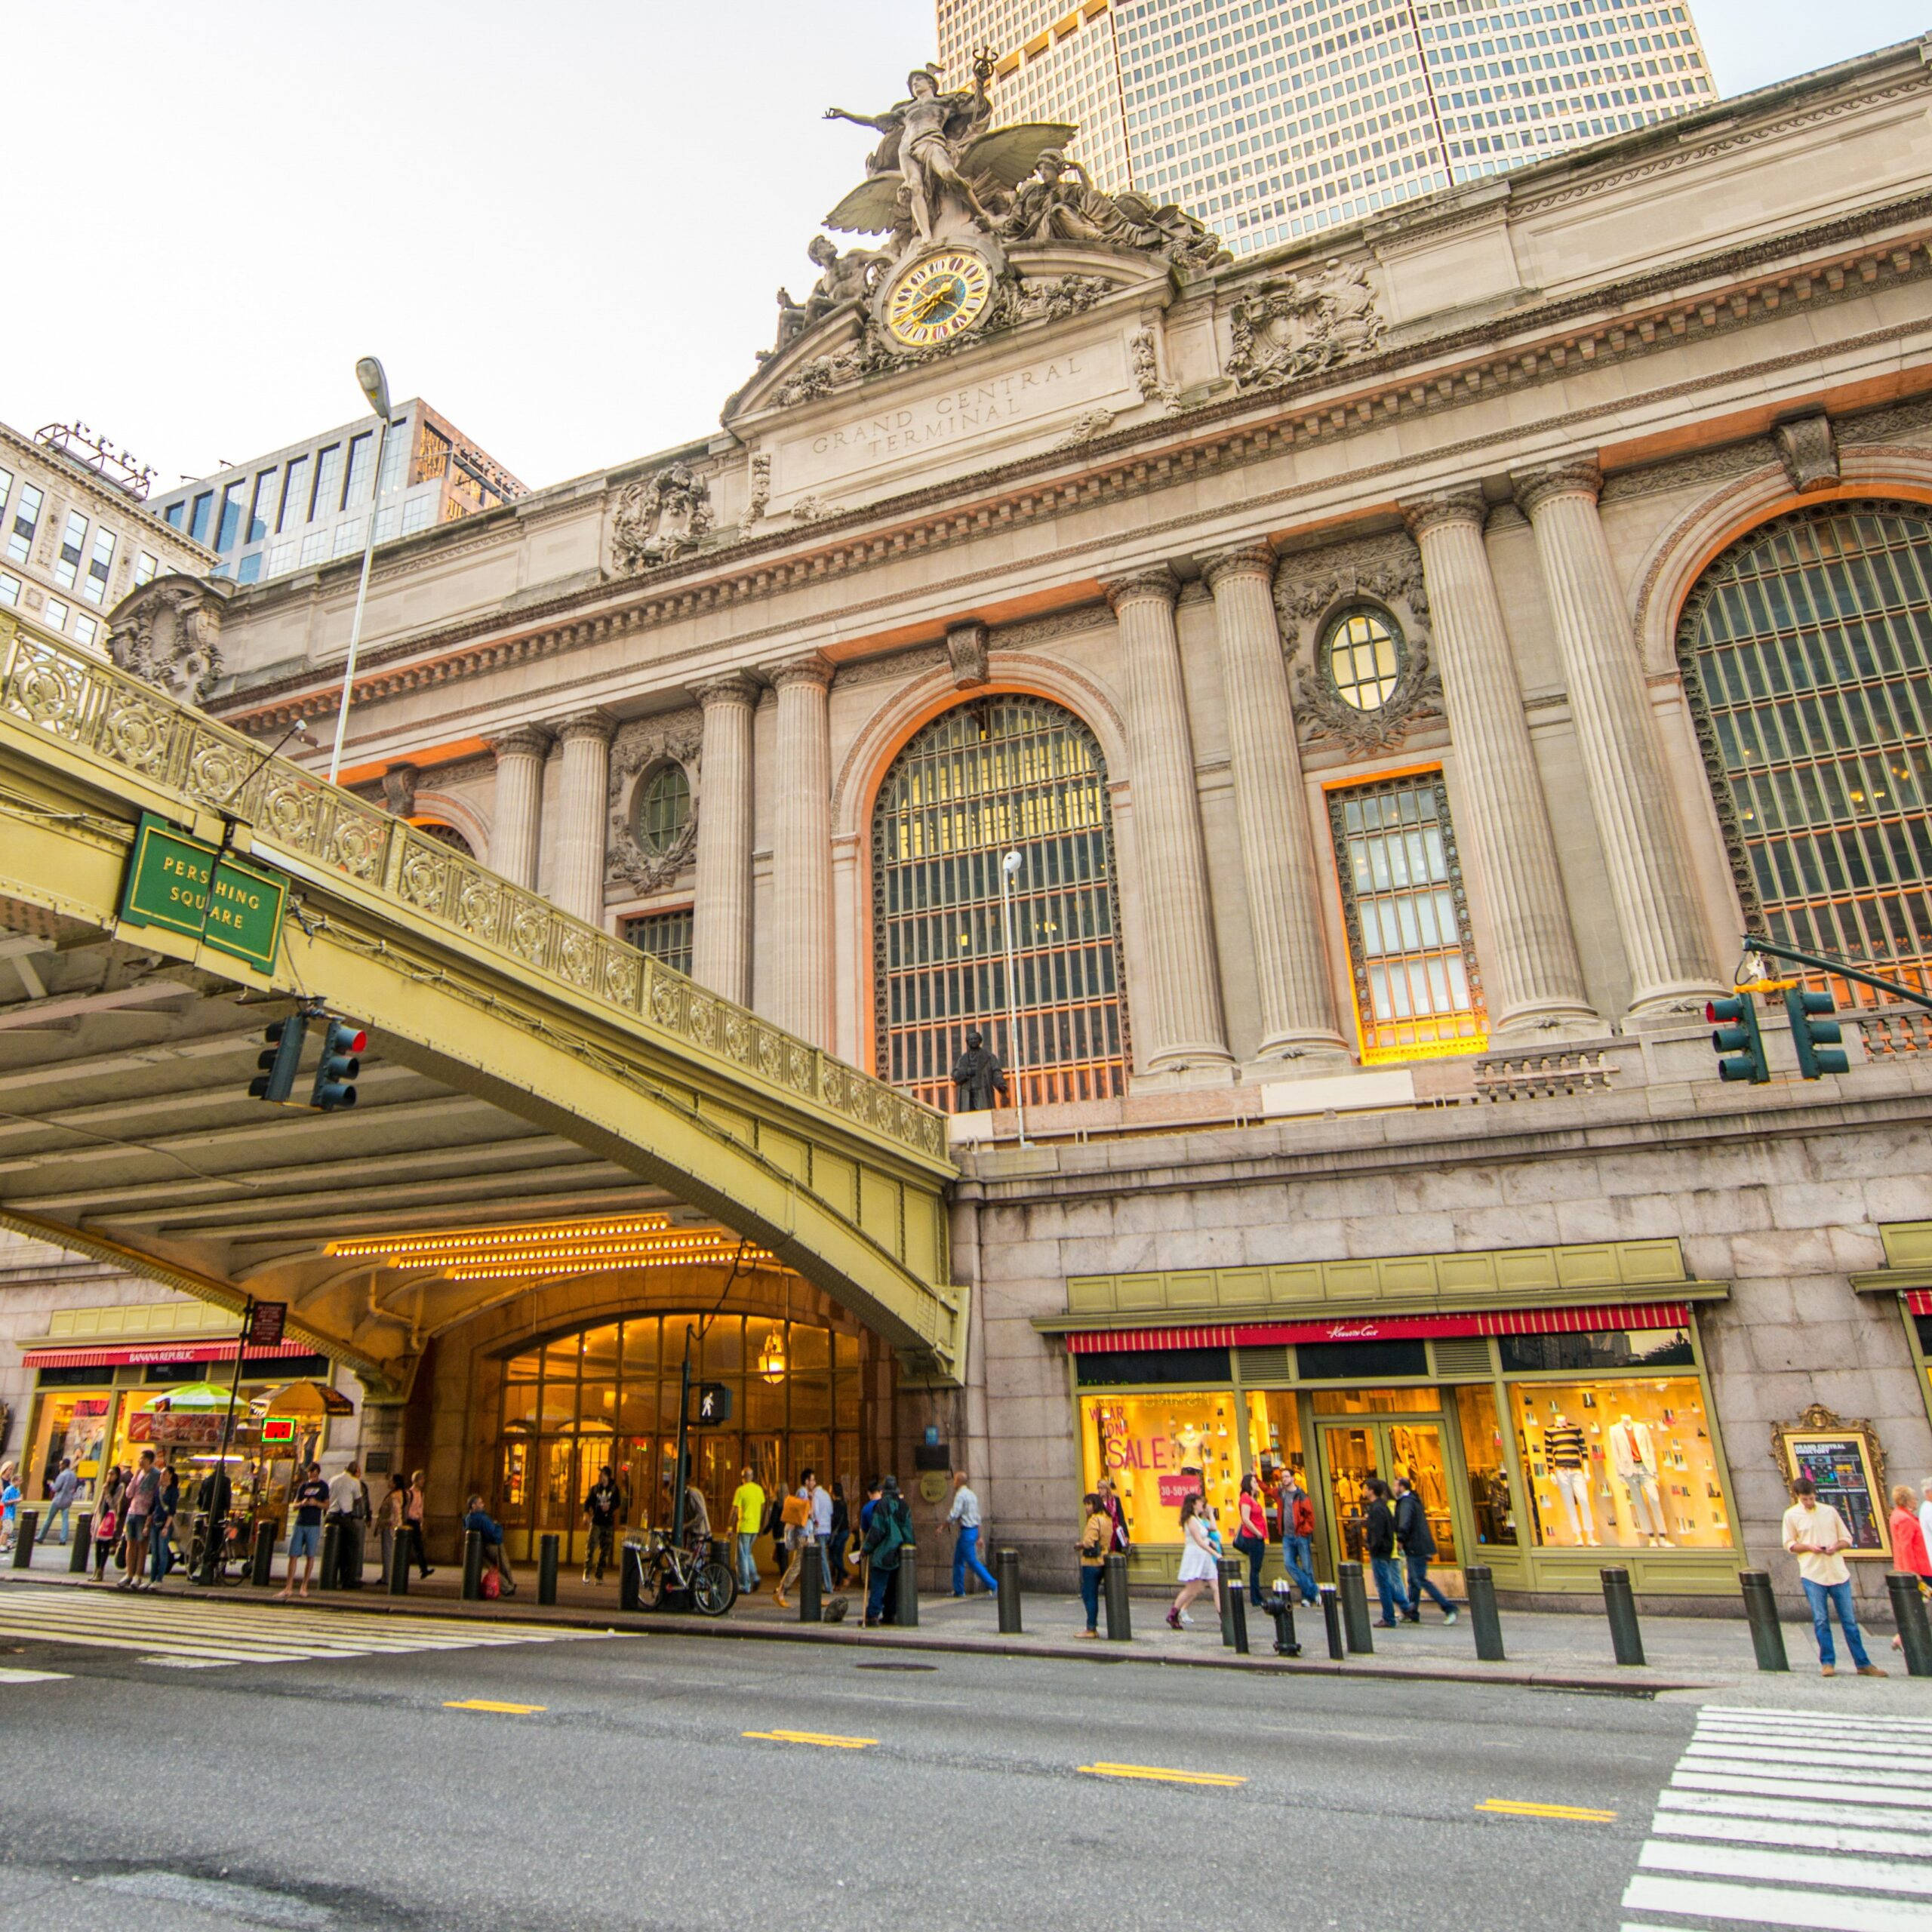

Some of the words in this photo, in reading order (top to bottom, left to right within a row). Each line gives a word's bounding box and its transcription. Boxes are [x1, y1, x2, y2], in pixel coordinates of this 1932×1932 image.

[813, 411, 912, 454] GRAND
[936, 358, 1082, 414] CENTRAL
[869, 398, 1020, 457] TERMINAL
[163, 857, 260, 910] PERSHING
[169, 886, 243, 929] SQUARE
[129, 1352, 158, 1362] BANANA
[159, 1350, 195, 1361] REPUBLIC
[1107, 1437, 1168, 1470] SALE
